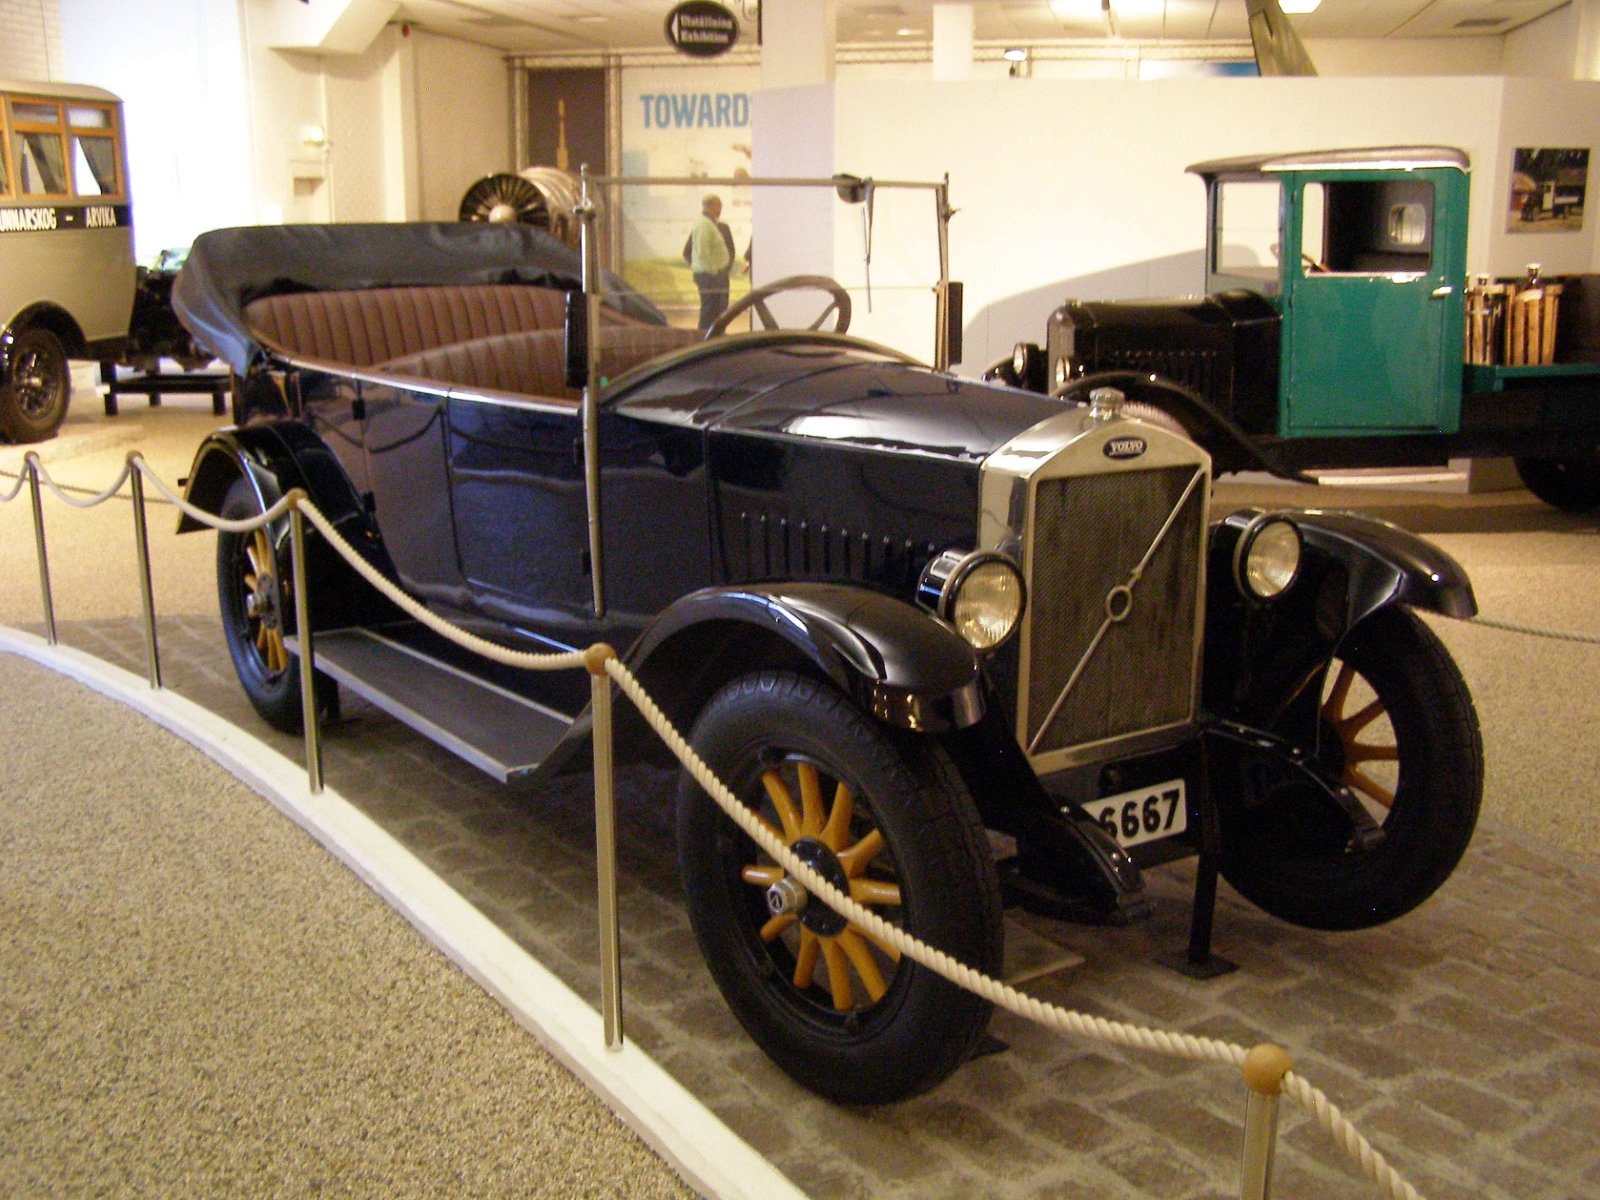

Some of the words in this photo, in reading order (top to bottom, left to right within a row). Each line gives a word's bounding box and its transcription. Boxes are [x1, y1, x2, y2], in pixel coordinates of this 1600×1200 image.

[640, 93, 752, 129] TOWARD
[86, 207, 117, 228] ARVIKA
[1109, 440, 1144, 454] VOLVO
[1099, 788, 1180, 838] 6667
